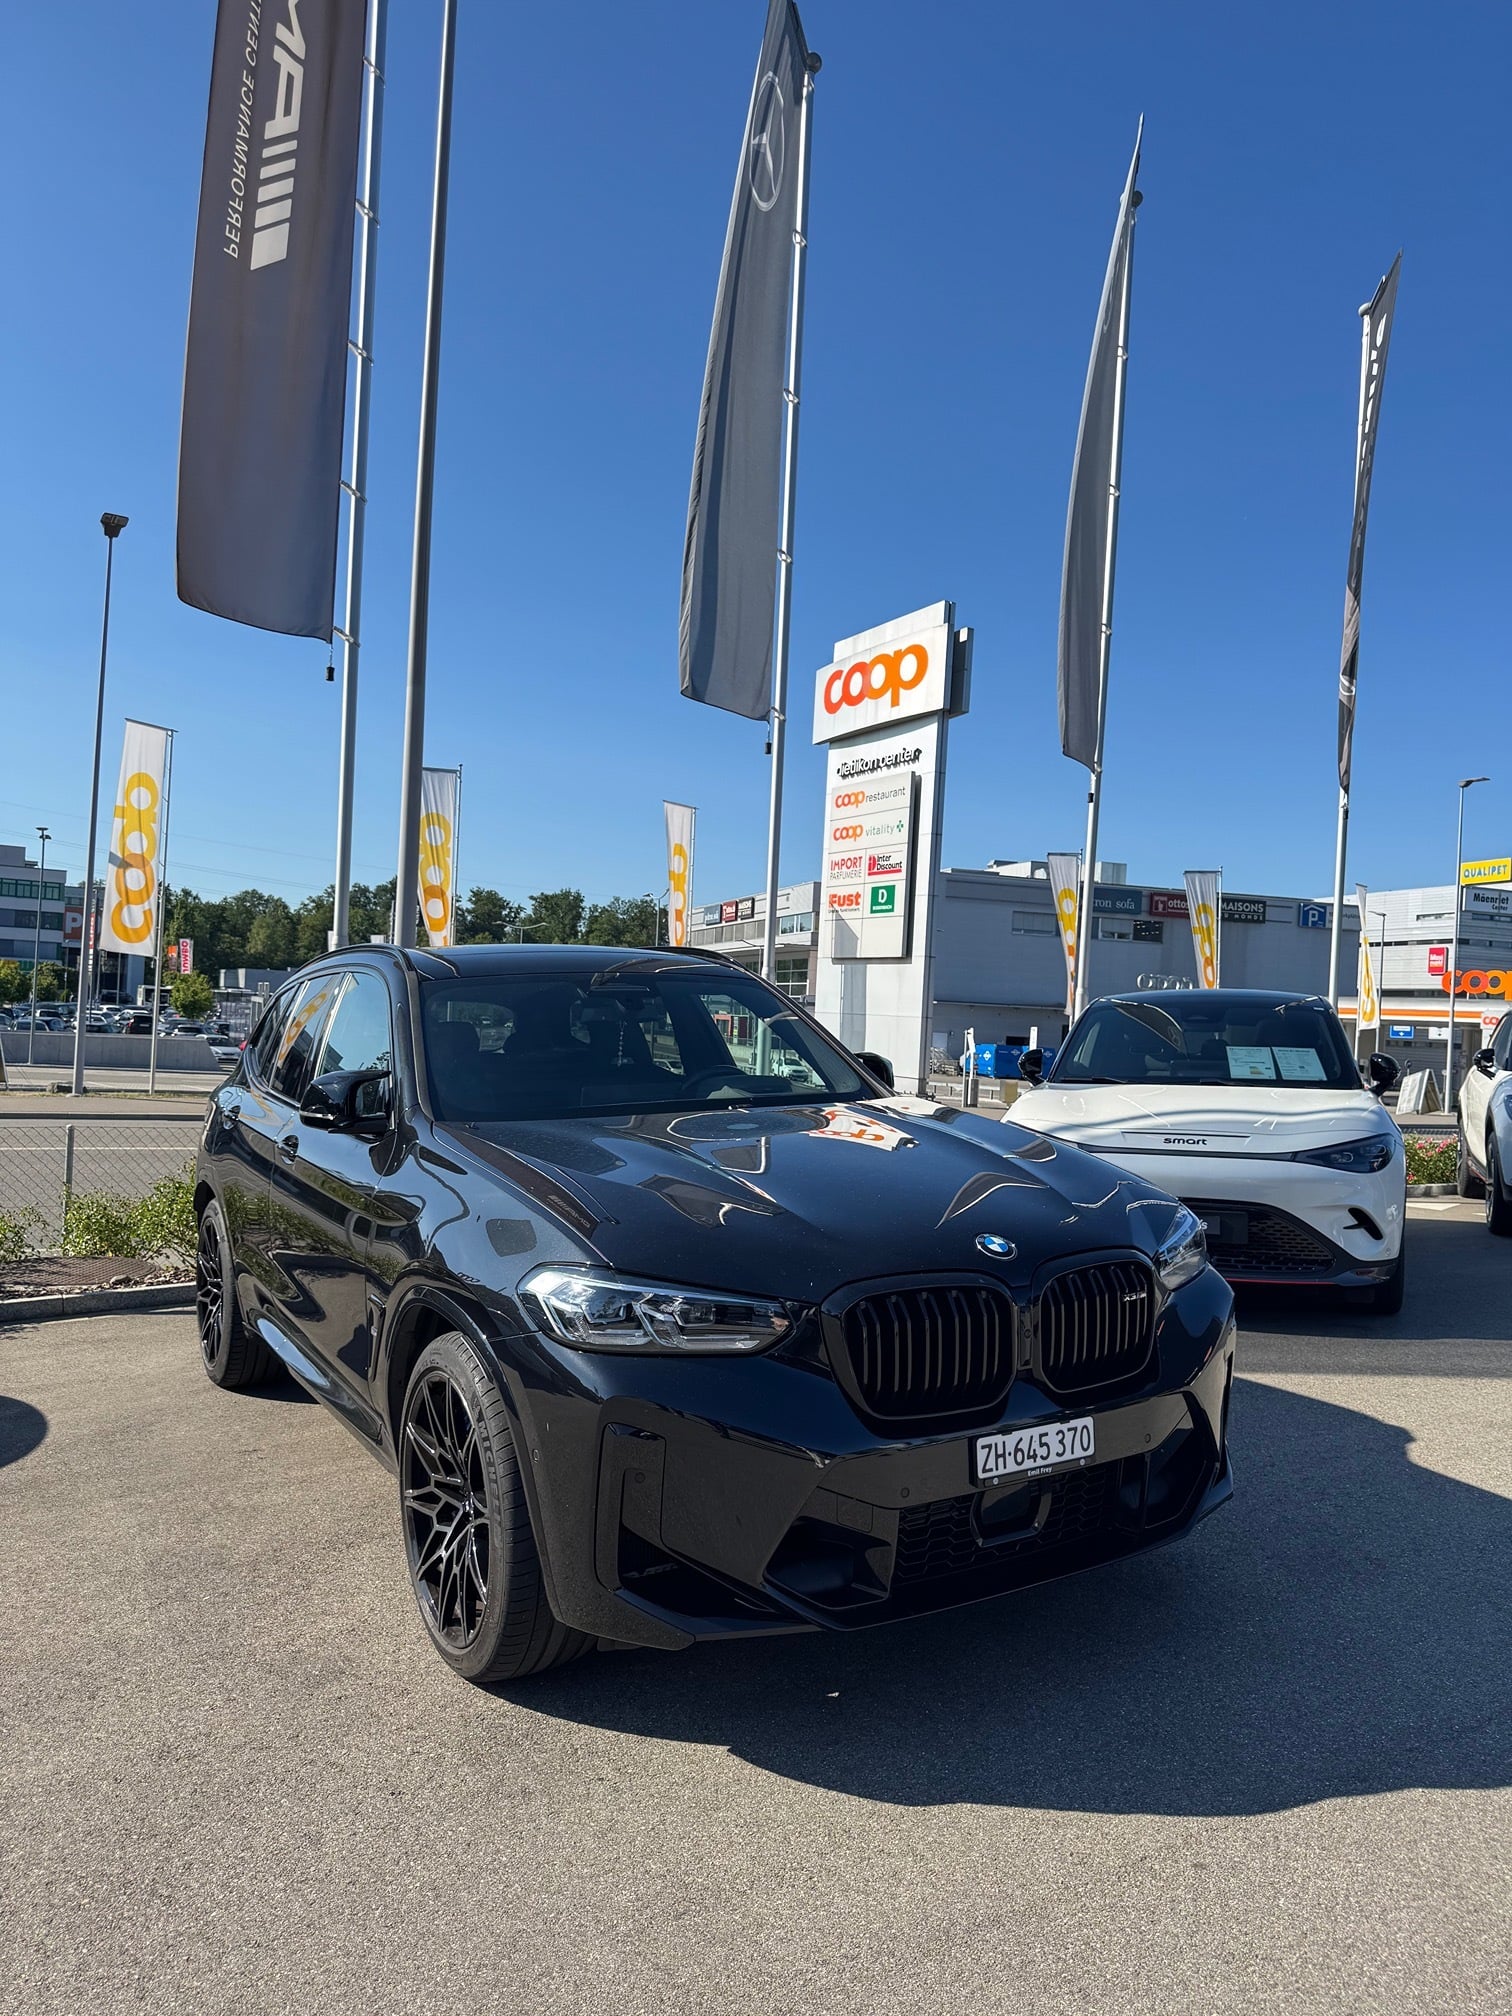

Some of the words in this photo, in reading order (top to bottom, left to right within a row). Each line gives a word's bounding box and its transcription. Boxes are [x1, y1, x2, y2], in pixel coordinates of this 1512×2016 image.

[823, 643, 929, 715] coop
[835, 791, 865, 808] coop
[865, 786, 906, 803] restaurant
[833, 824, 864, 842] coop
[865, 823, 895, 837] vitality
[830, 856, 863, 871] IMPORT
[877, 855, 892, 863] Inter
[876, 861, 903, 871] Discount
[1463, 864, 1508, 878] QUALIPET
[830, 869, 862, 880] PARFUMERIE
[829, 891, 861, 908] Fust
[1168, 898, 1189, 909] otto
[1221, 901, 1264, 913] MAISONS
[1482, 1015, 1500, 1025] co
[1162, 1137, 1208, 1146] smart
[479, 1419, 501, 1548] MICHELIN
